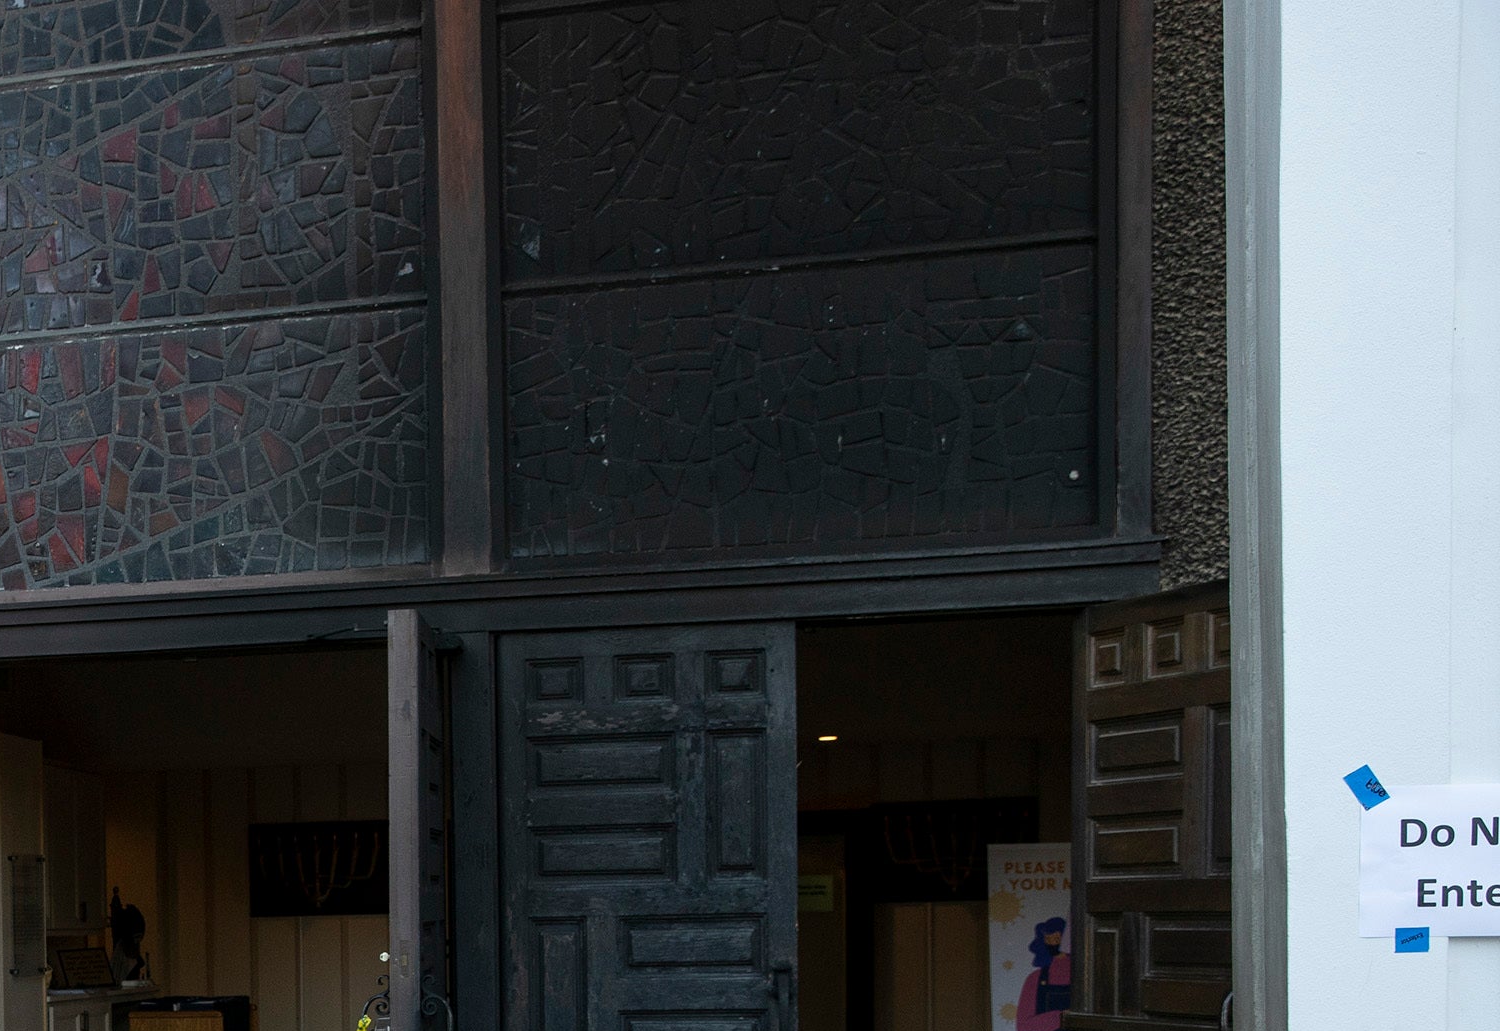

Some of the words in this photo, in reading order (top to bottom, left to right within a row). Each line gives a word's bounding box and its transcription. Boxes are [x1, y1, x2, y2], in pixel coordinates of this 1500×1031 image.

[1400, 818, 1455, 847] Do
[1004, 861, 1065, 874] PLEASE
[1010, 878, 1056, 891] YOUR
[1417, 879, 1500, 907] Ente
